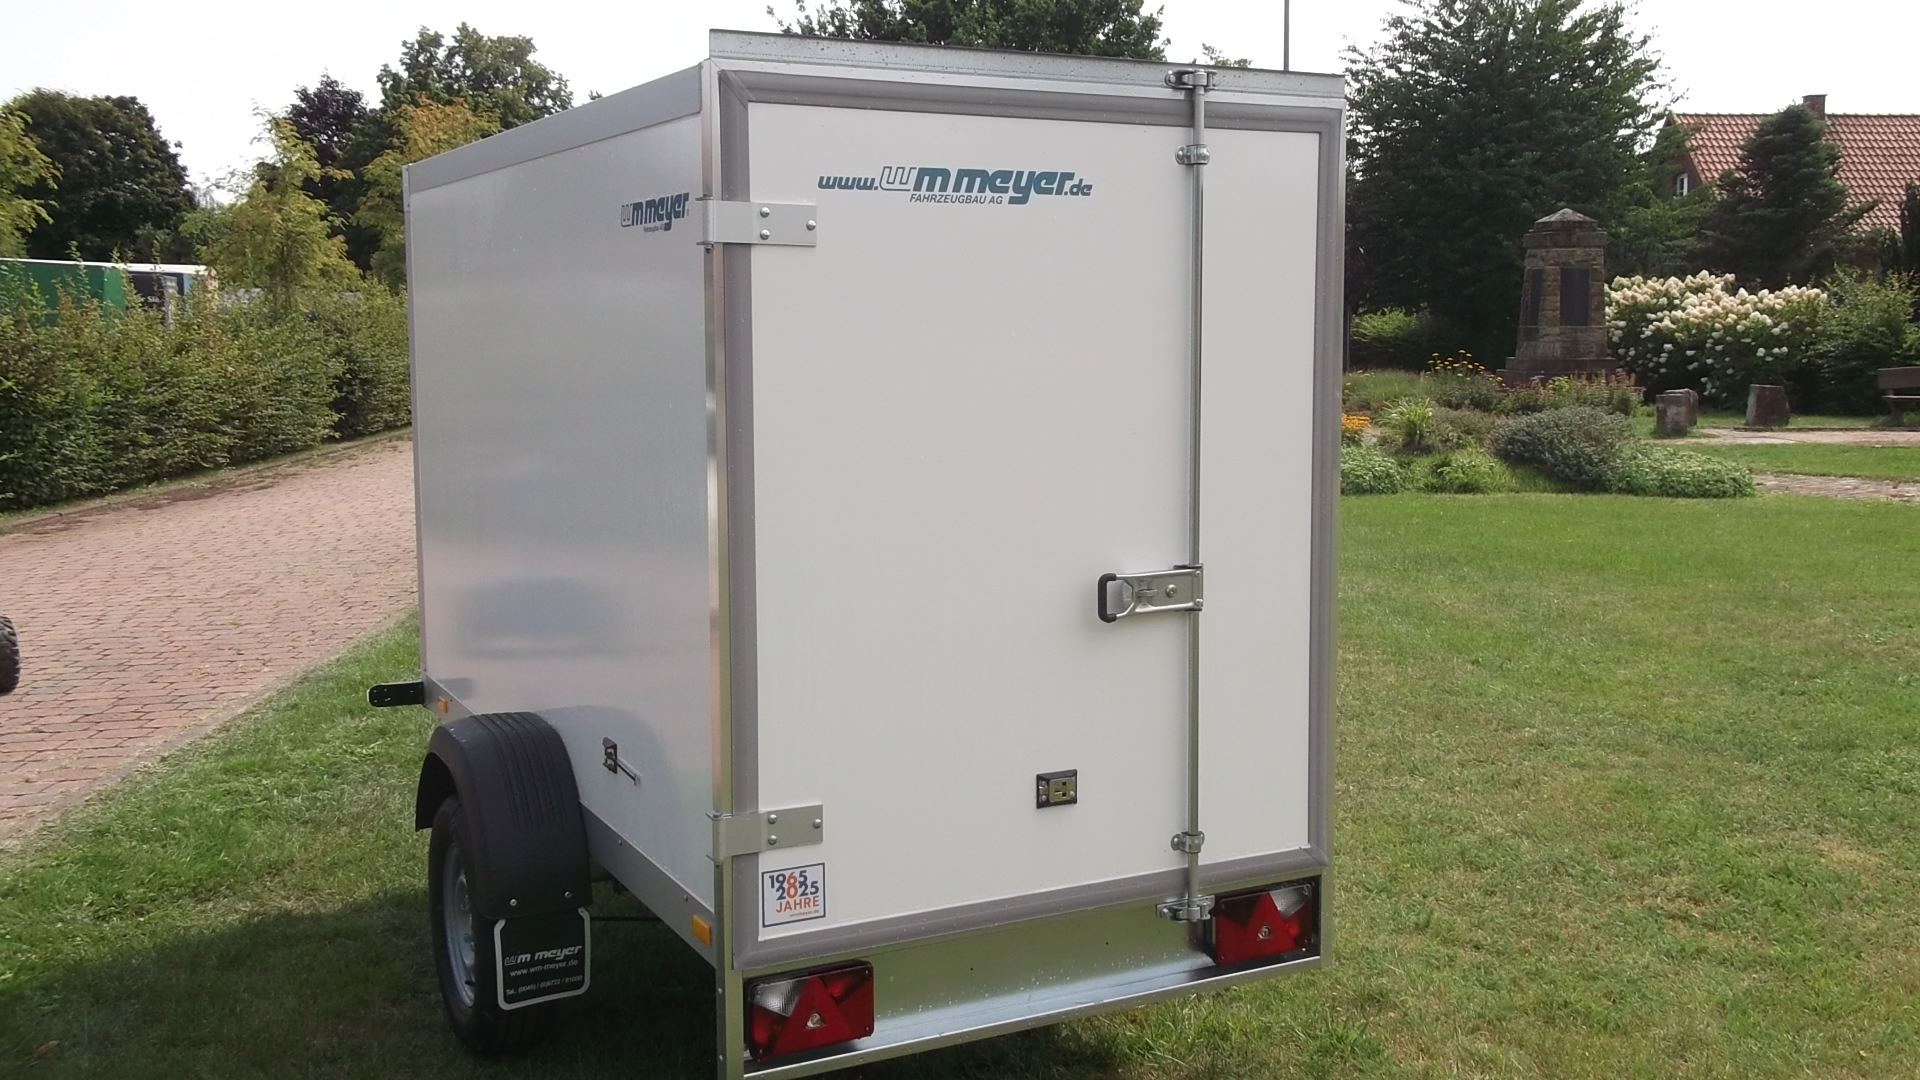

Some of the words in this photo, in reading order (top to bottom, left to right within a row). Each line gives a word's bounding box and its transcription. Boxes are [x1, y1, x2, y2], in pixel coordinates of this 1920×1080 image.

[909, 193, 987, 204] FAHRZEUGBAU
[988, 195, 1003, 205] AG
[769, 870, 808, 890] 1965
[775, 881, 820, 901] 2025
[776, 896, 820, 913] JAHRE
[504, 953, 531, 966] wm
[534, 945, 583, 960] meyer
[509, 959, 579, 977] www.wm-meyer.de
